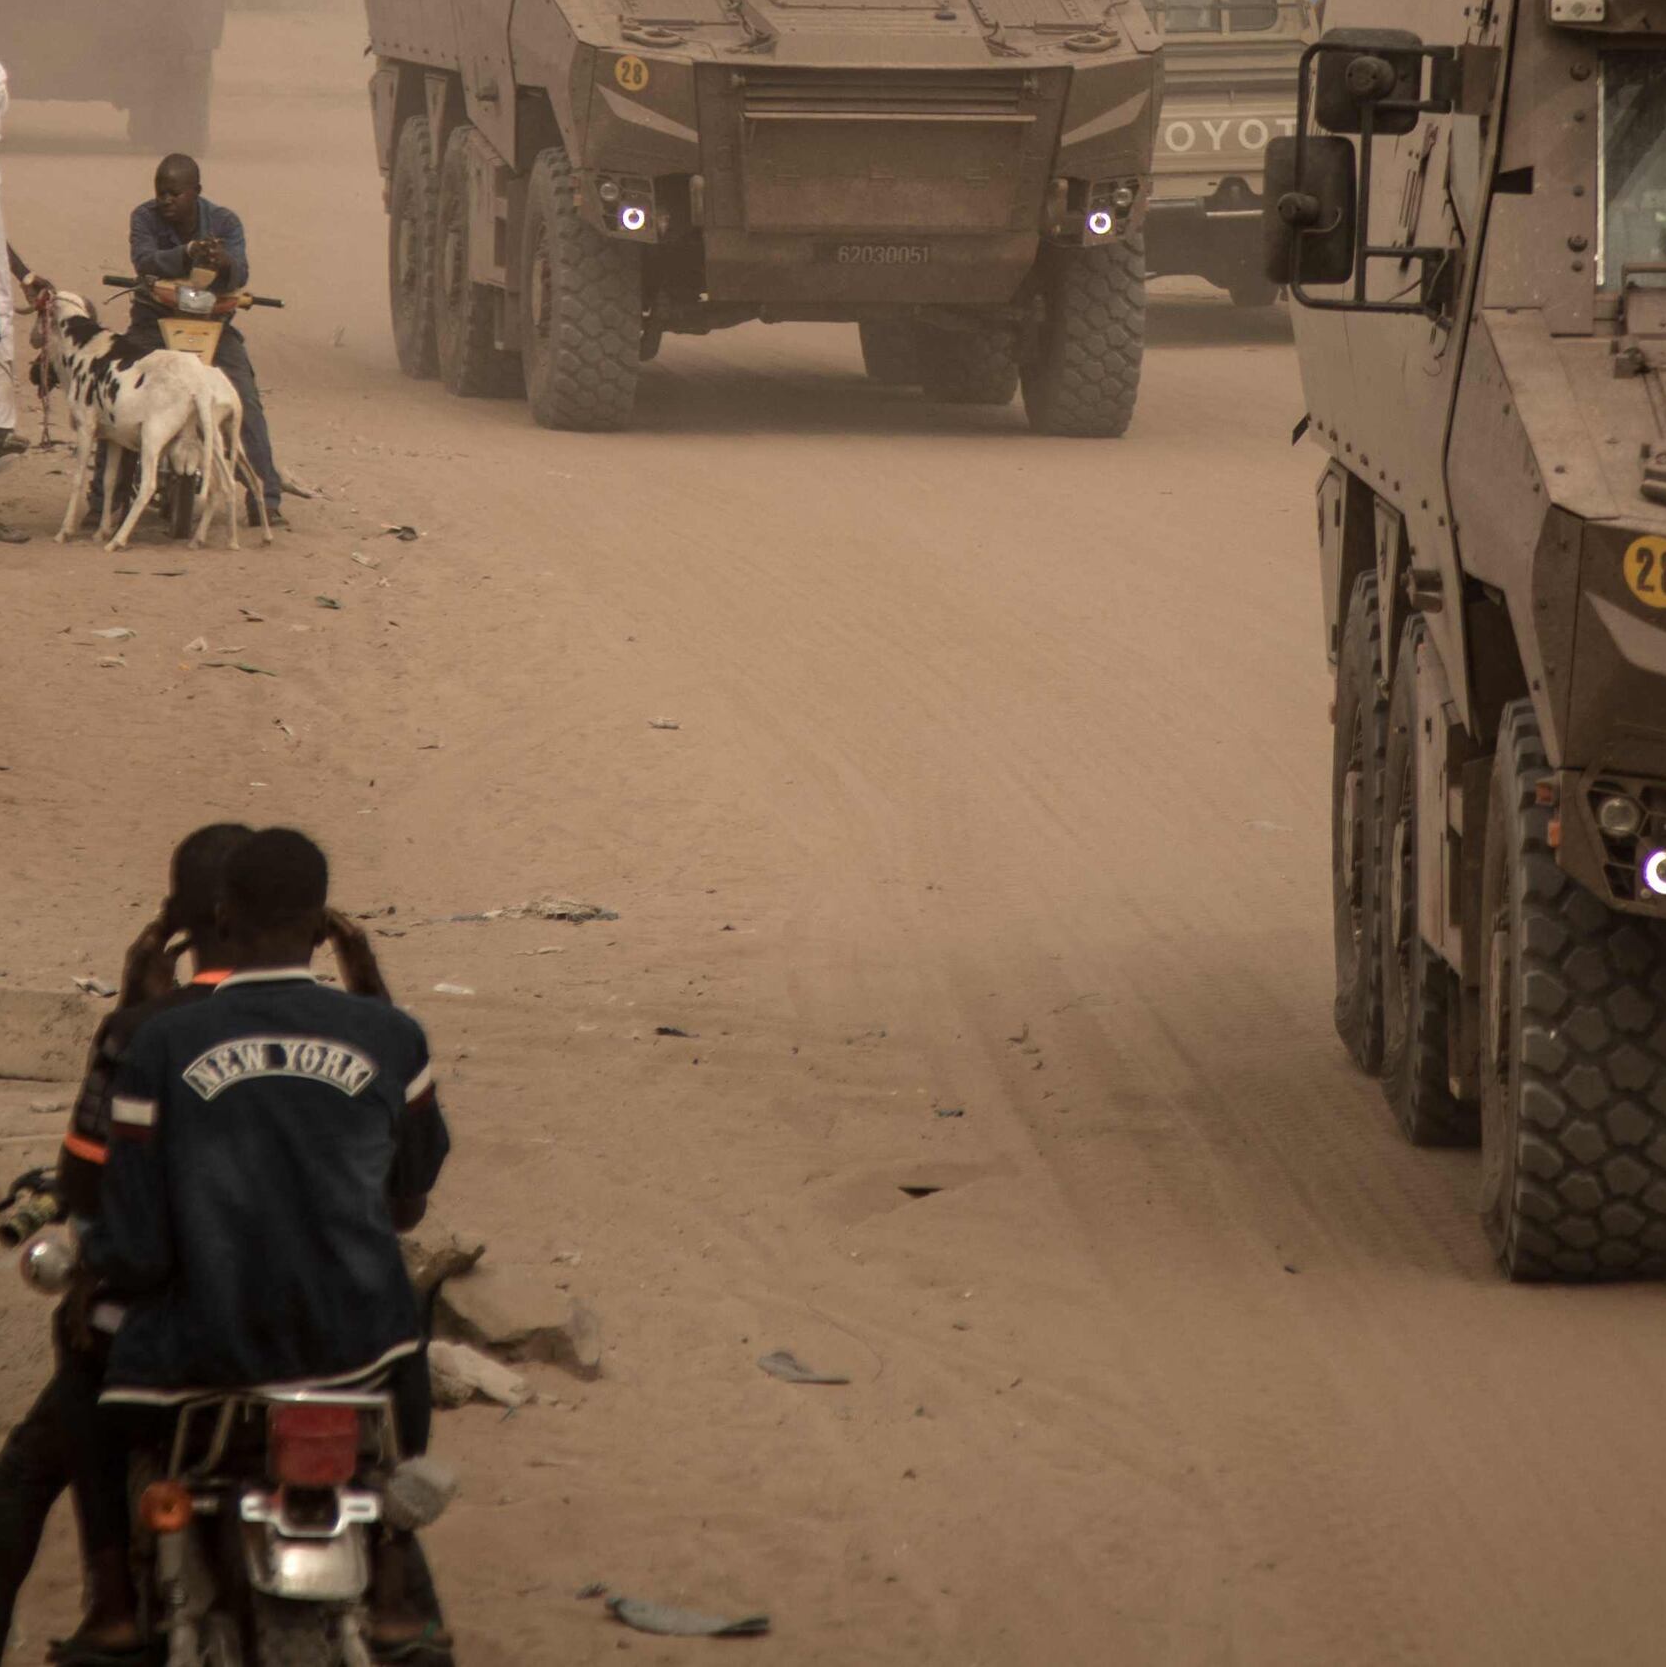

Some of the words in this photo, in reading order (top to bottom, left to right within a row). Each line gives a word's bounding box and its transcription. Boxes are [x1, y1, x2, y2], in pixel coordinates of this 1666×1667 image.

[621, 61, 642, 85] 28
[1165, 118, 1298, 152] OYOT
[837, 245, 929, 264] 62030051
[187, 1043, 267, 1092] NEW
[280, 1042, 371, 1093] YORK
